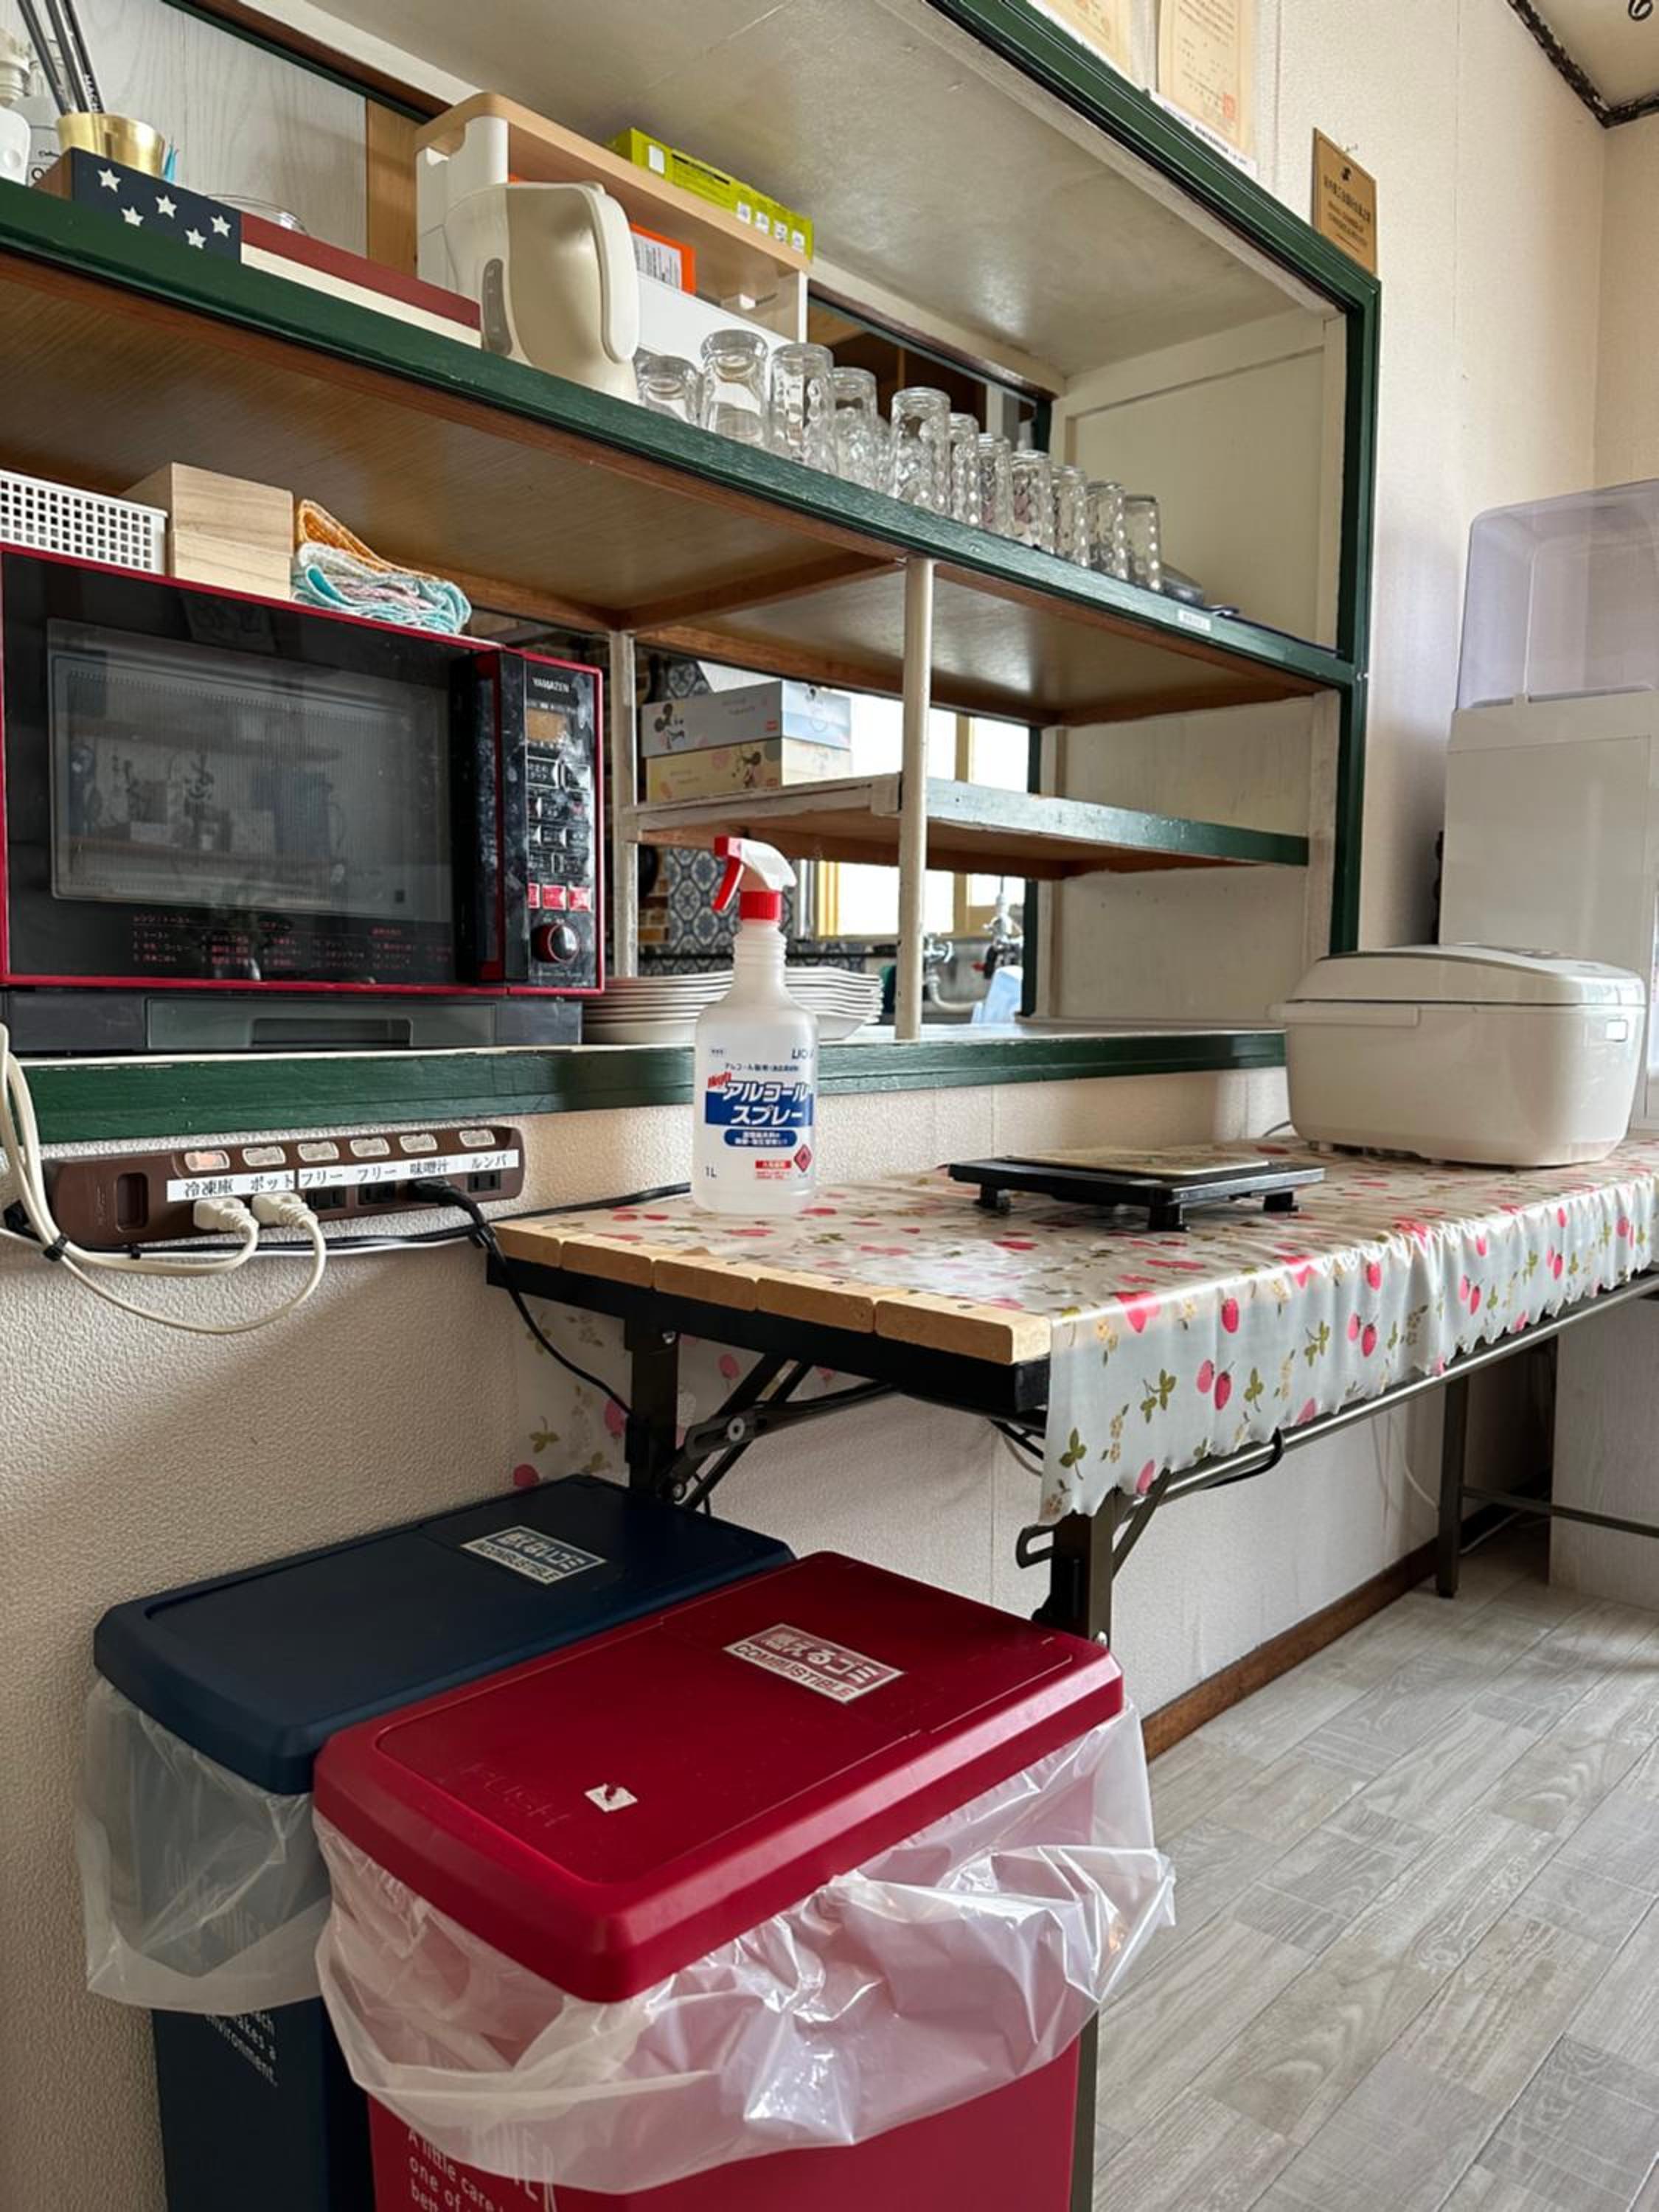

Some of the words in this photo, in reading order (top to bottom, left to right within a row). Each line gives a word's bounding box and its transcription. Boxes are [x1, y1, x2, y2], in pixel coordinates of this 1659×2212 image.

[723, 1082, 810, 1102] アルコール
[730, 1105, 804, 1126] スプレー
[249, 1175, 293, 1192] ポット
[301, 1169, 343, 1186] フリー
[357, 1166, 397, 1181] フリー
[409, 1158, 448, 1175] 味噌汁
[733, 1643, 856, 1697] COMBUSTIBLE
[408, 2155, 440, 2194] one
